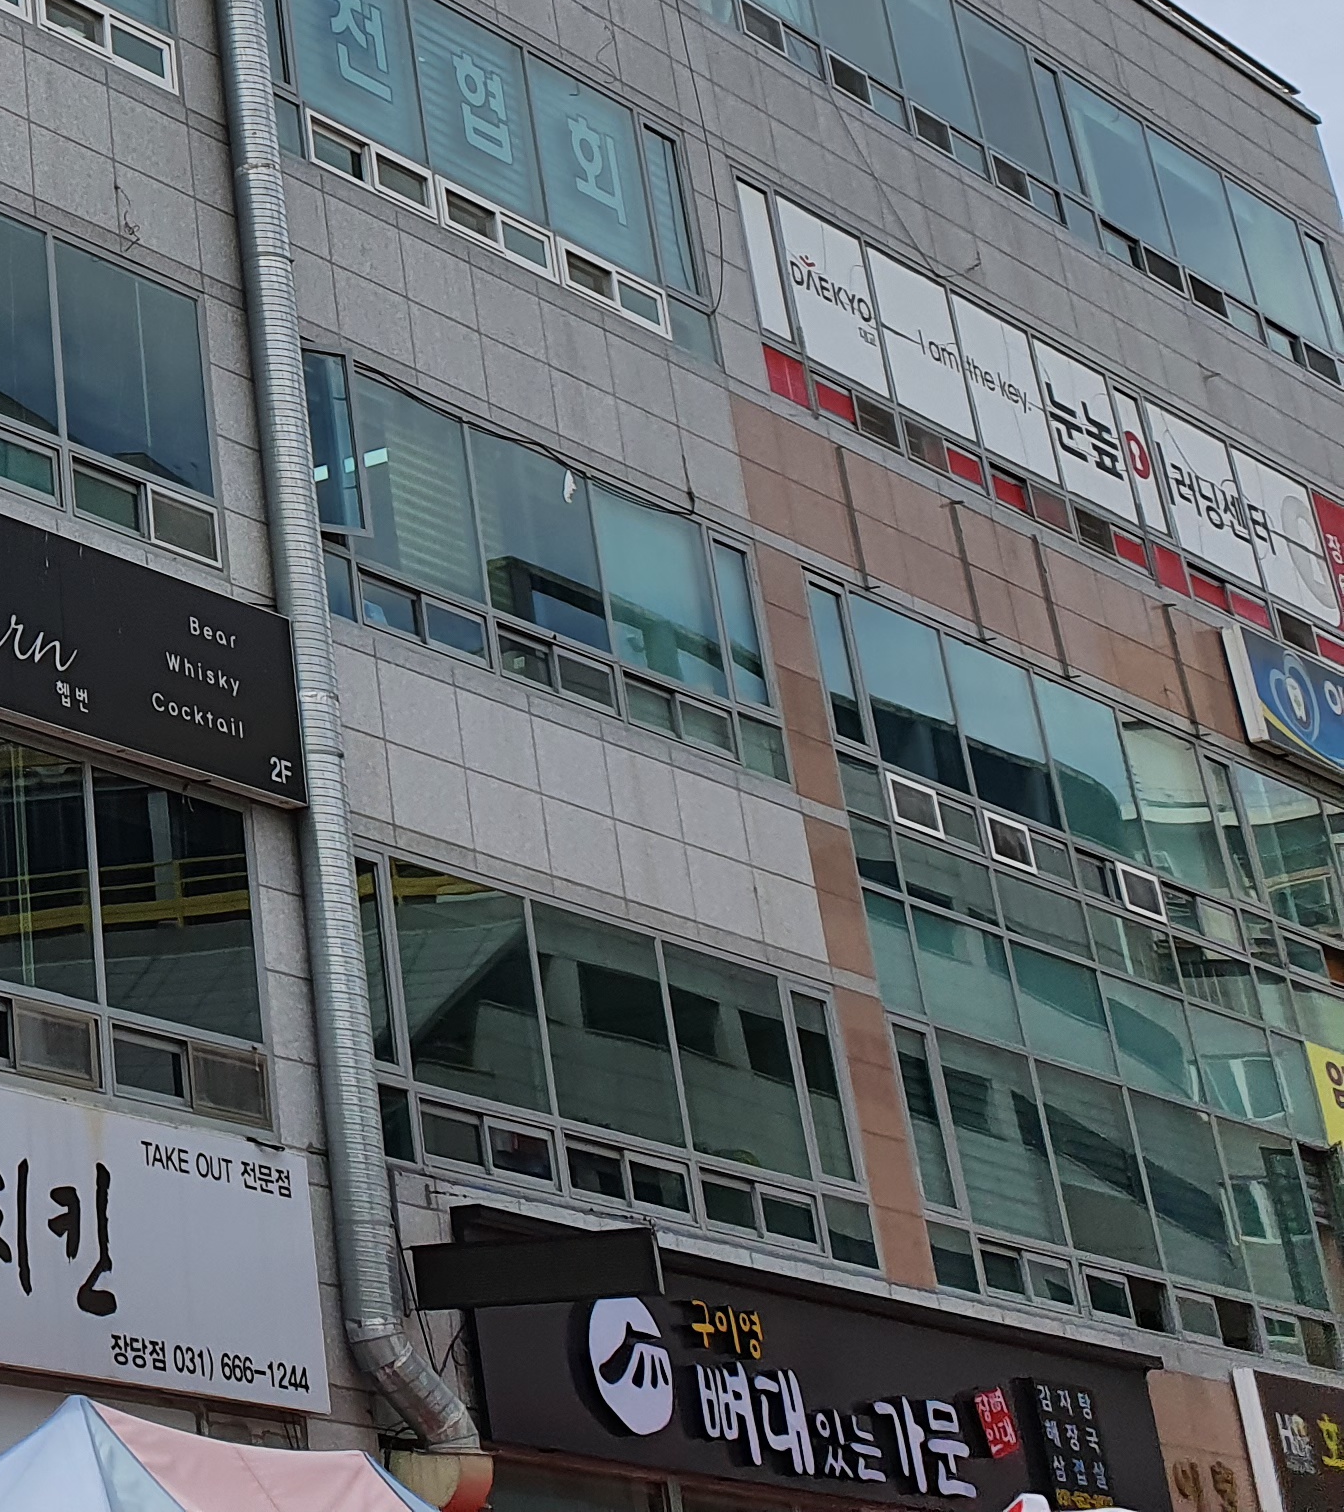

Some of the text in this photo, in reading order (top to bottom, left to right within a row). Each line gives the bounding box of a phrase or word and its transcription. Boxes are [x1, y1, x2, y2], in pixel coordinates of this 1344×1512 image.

[789, 254, 874, 324] DAEKYO
[928, 341, 961, 374] am
[965, 354, 997, 393] the
[997, 372, 1033, 414] key.
[1044, 381, 1278, 556] 눈높이 러닝센터
[188, 614, 239, 650] Bear
[55, 678, 90, 716] 헵번
[165, 651, 243, 697] Whisky
[150, 691, 246, 740] Cocktail
[268, 755, 295, 786] 2F
[140, 1140, 293, 1199] TAKE OUT 전문점
[110, 1333, 311, 1393] 장당점 031) 666-1244
